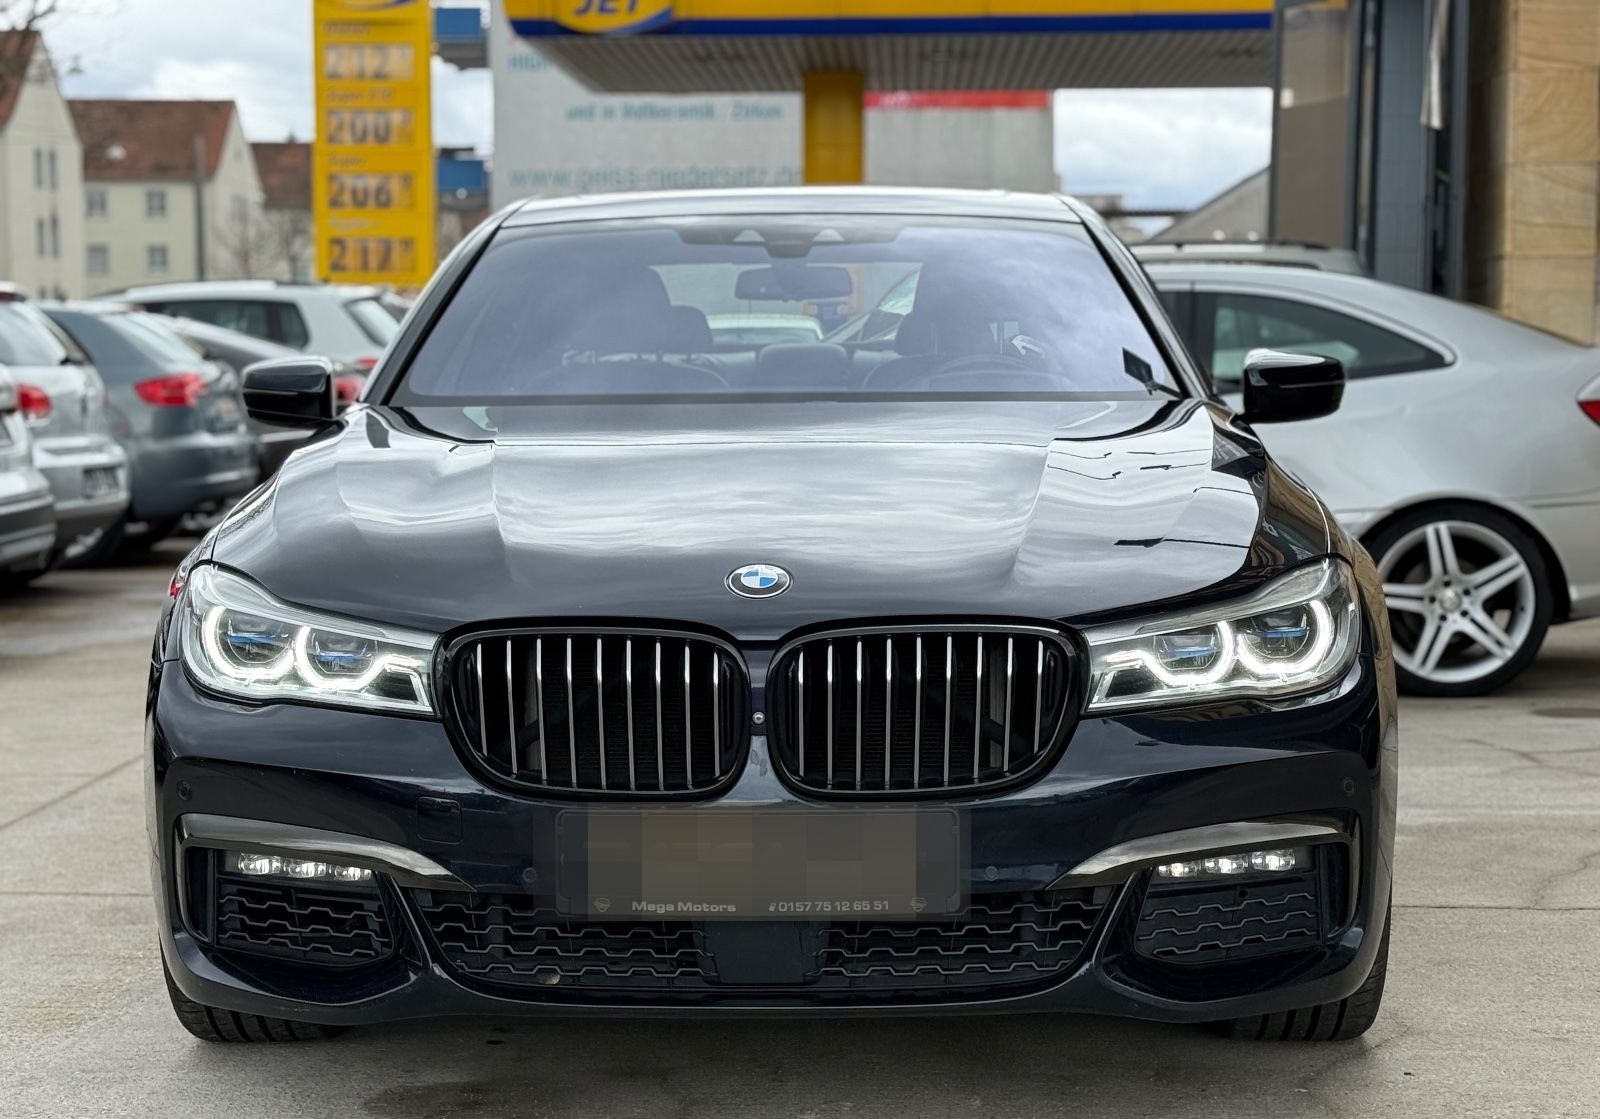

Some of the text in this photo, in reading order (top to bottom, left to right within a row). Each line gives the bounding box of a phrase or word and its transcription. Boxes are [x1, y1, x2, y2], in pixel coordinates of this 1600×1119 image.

[328, 173, 392, 208] 206
[329, 237, 393, 273] 217
[631, 901, 737, 914] Mega Motors
[778, 900, 889, 912] 0157 75 12 65 51
